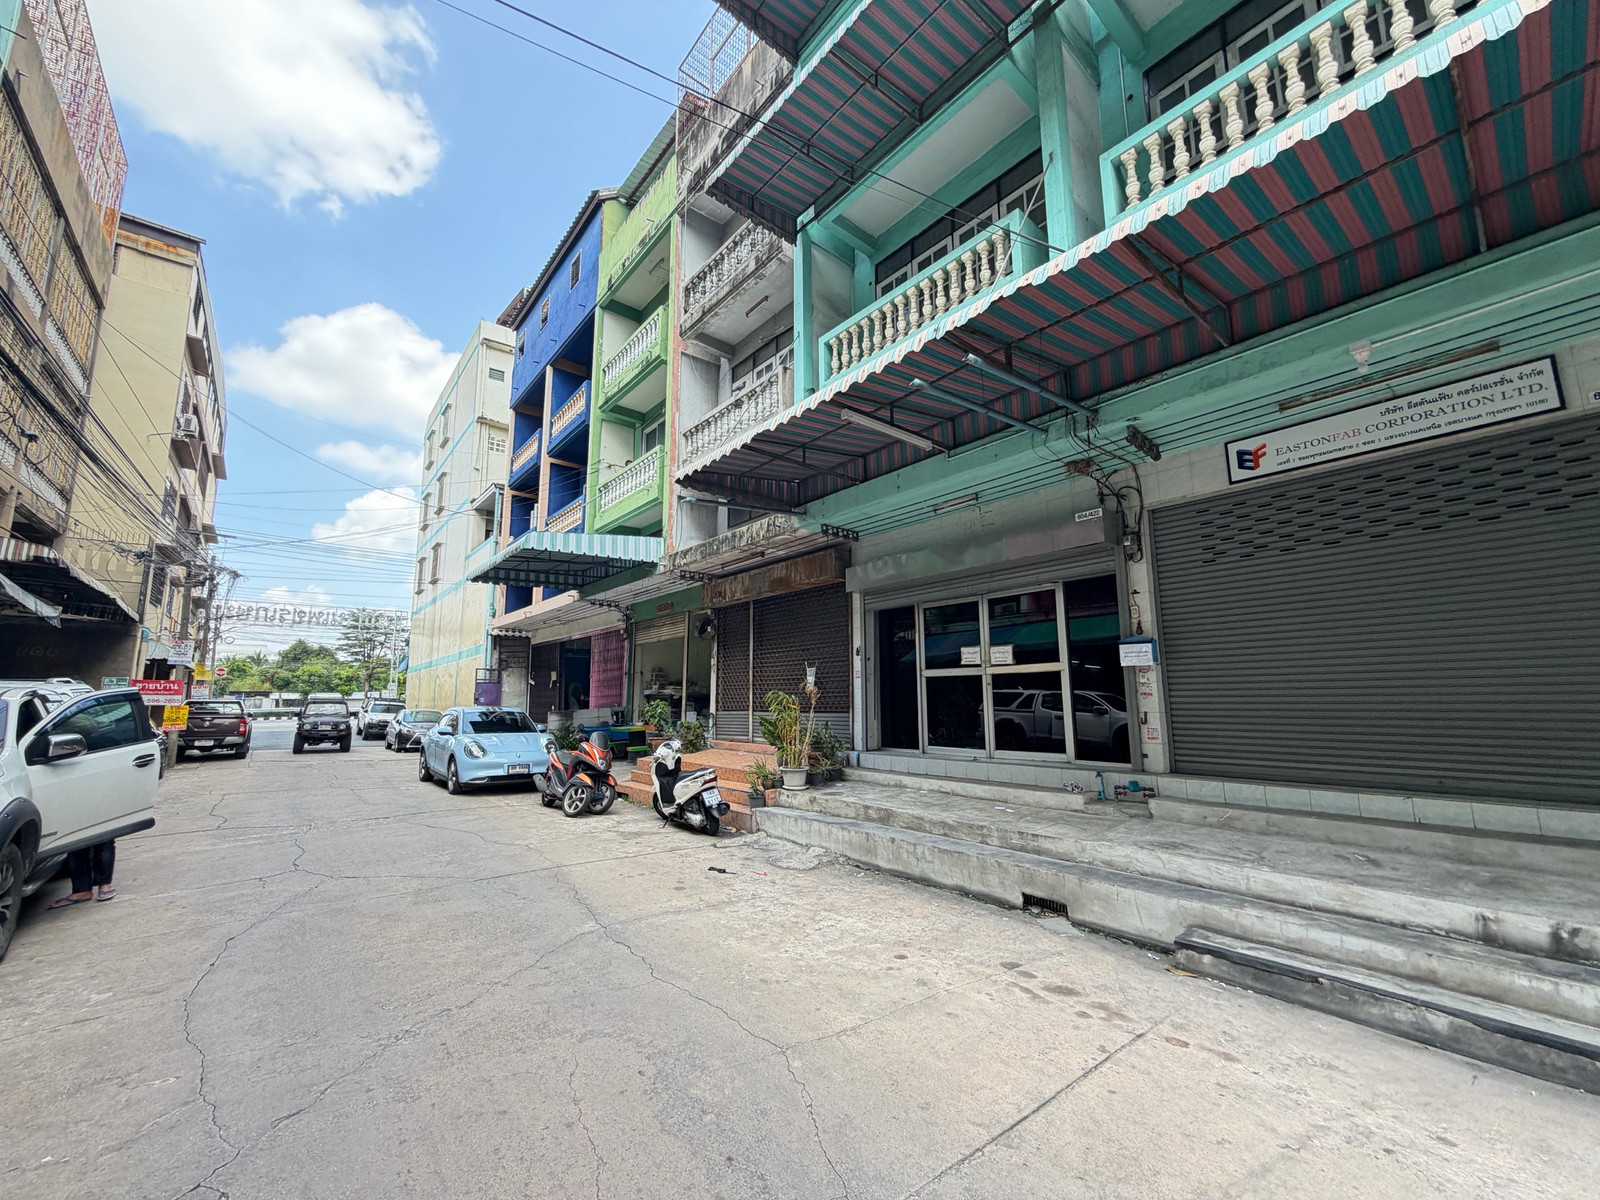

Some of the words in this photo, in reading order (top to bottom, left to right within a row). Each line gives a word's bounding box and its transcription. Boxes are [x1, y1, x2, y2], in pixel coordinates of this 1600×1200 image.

[1379, 404, 1404, 417] บริษัท
[1517, 368, 1544, 383] จำกัด
[1275, 427, 1362, 457] EASTONFAB
[1365, 393, 1496, 434] CORPORATION
[1501, 382, 1549, 401] LTD.
[135, 680, 179, 690] ขายบ้าน
